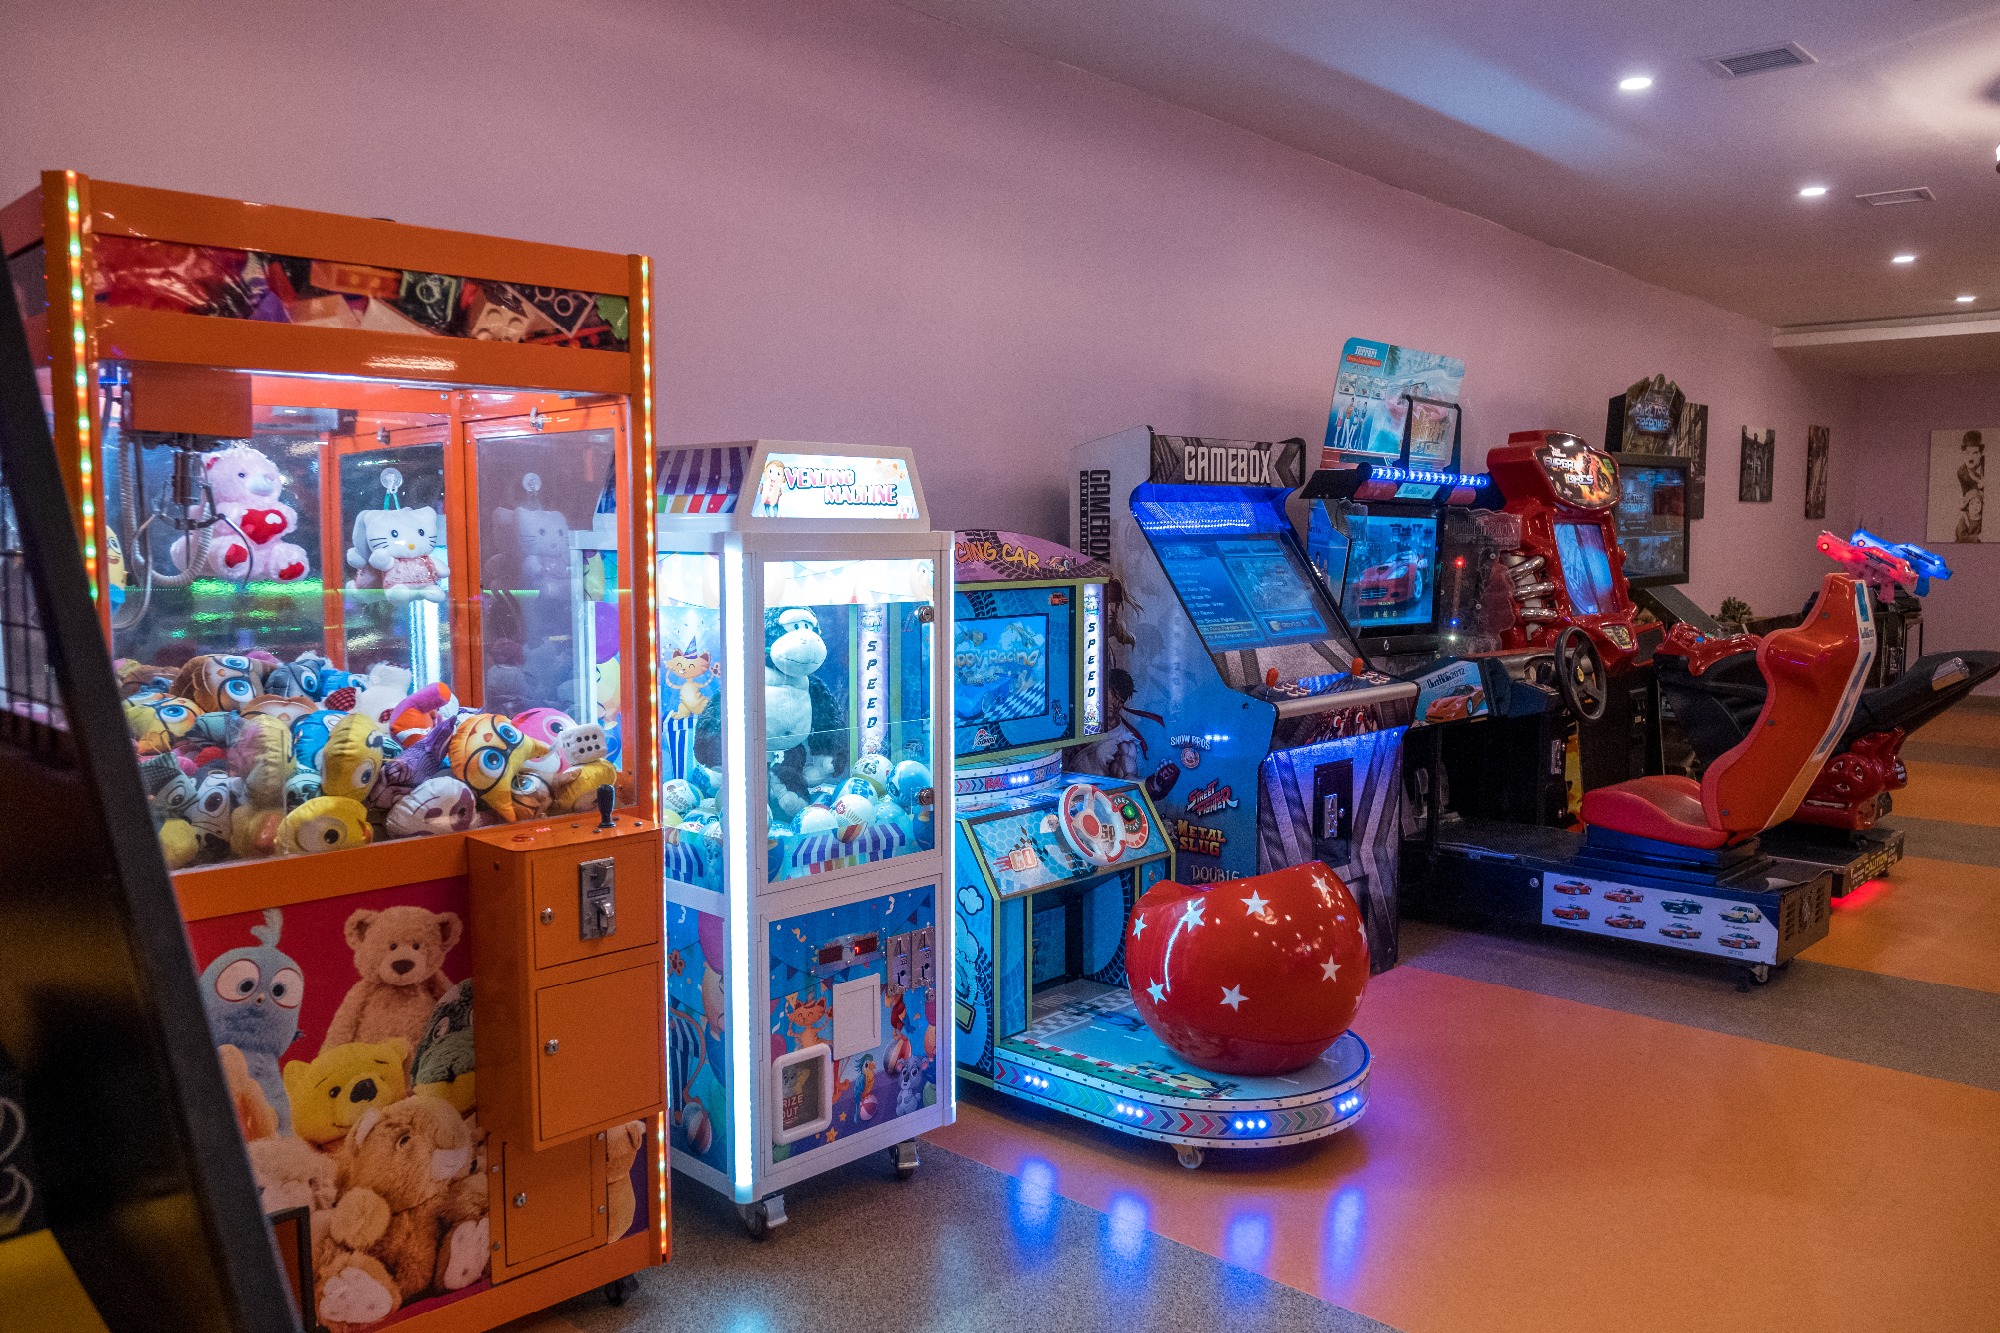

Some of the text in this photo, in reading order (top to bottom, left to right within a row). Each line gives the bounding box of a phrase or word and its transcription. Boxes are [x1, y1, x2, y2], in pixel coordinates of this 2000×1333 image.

[1184, 445, 1271, 484] GAMEBOX
[784, 467, 856, 489] VENDING
[824, 484, 897, 506] MACHINE
[1089, 469, 1111, 563] GAMEBOX
[955, 541, 1040, 572] CING CAR
[955, 649, 1040, 668] ppy Racing
[1088, 622, 1096, 698] SPEED
[866, 640, 878, 729] SPEED
[1170, 734, 1211, 750] SNOW BROS
[1187, 779, 1218, 811] STREET
[1177, 819, 1228, 843] METAL
[1180, 836, 1220, 857] SLUG
[1009, 848, 1037, 870] GO
[1190, 864, 1240, 882] DOUBLE
[783, 1094, 804, 1108] RIZE
